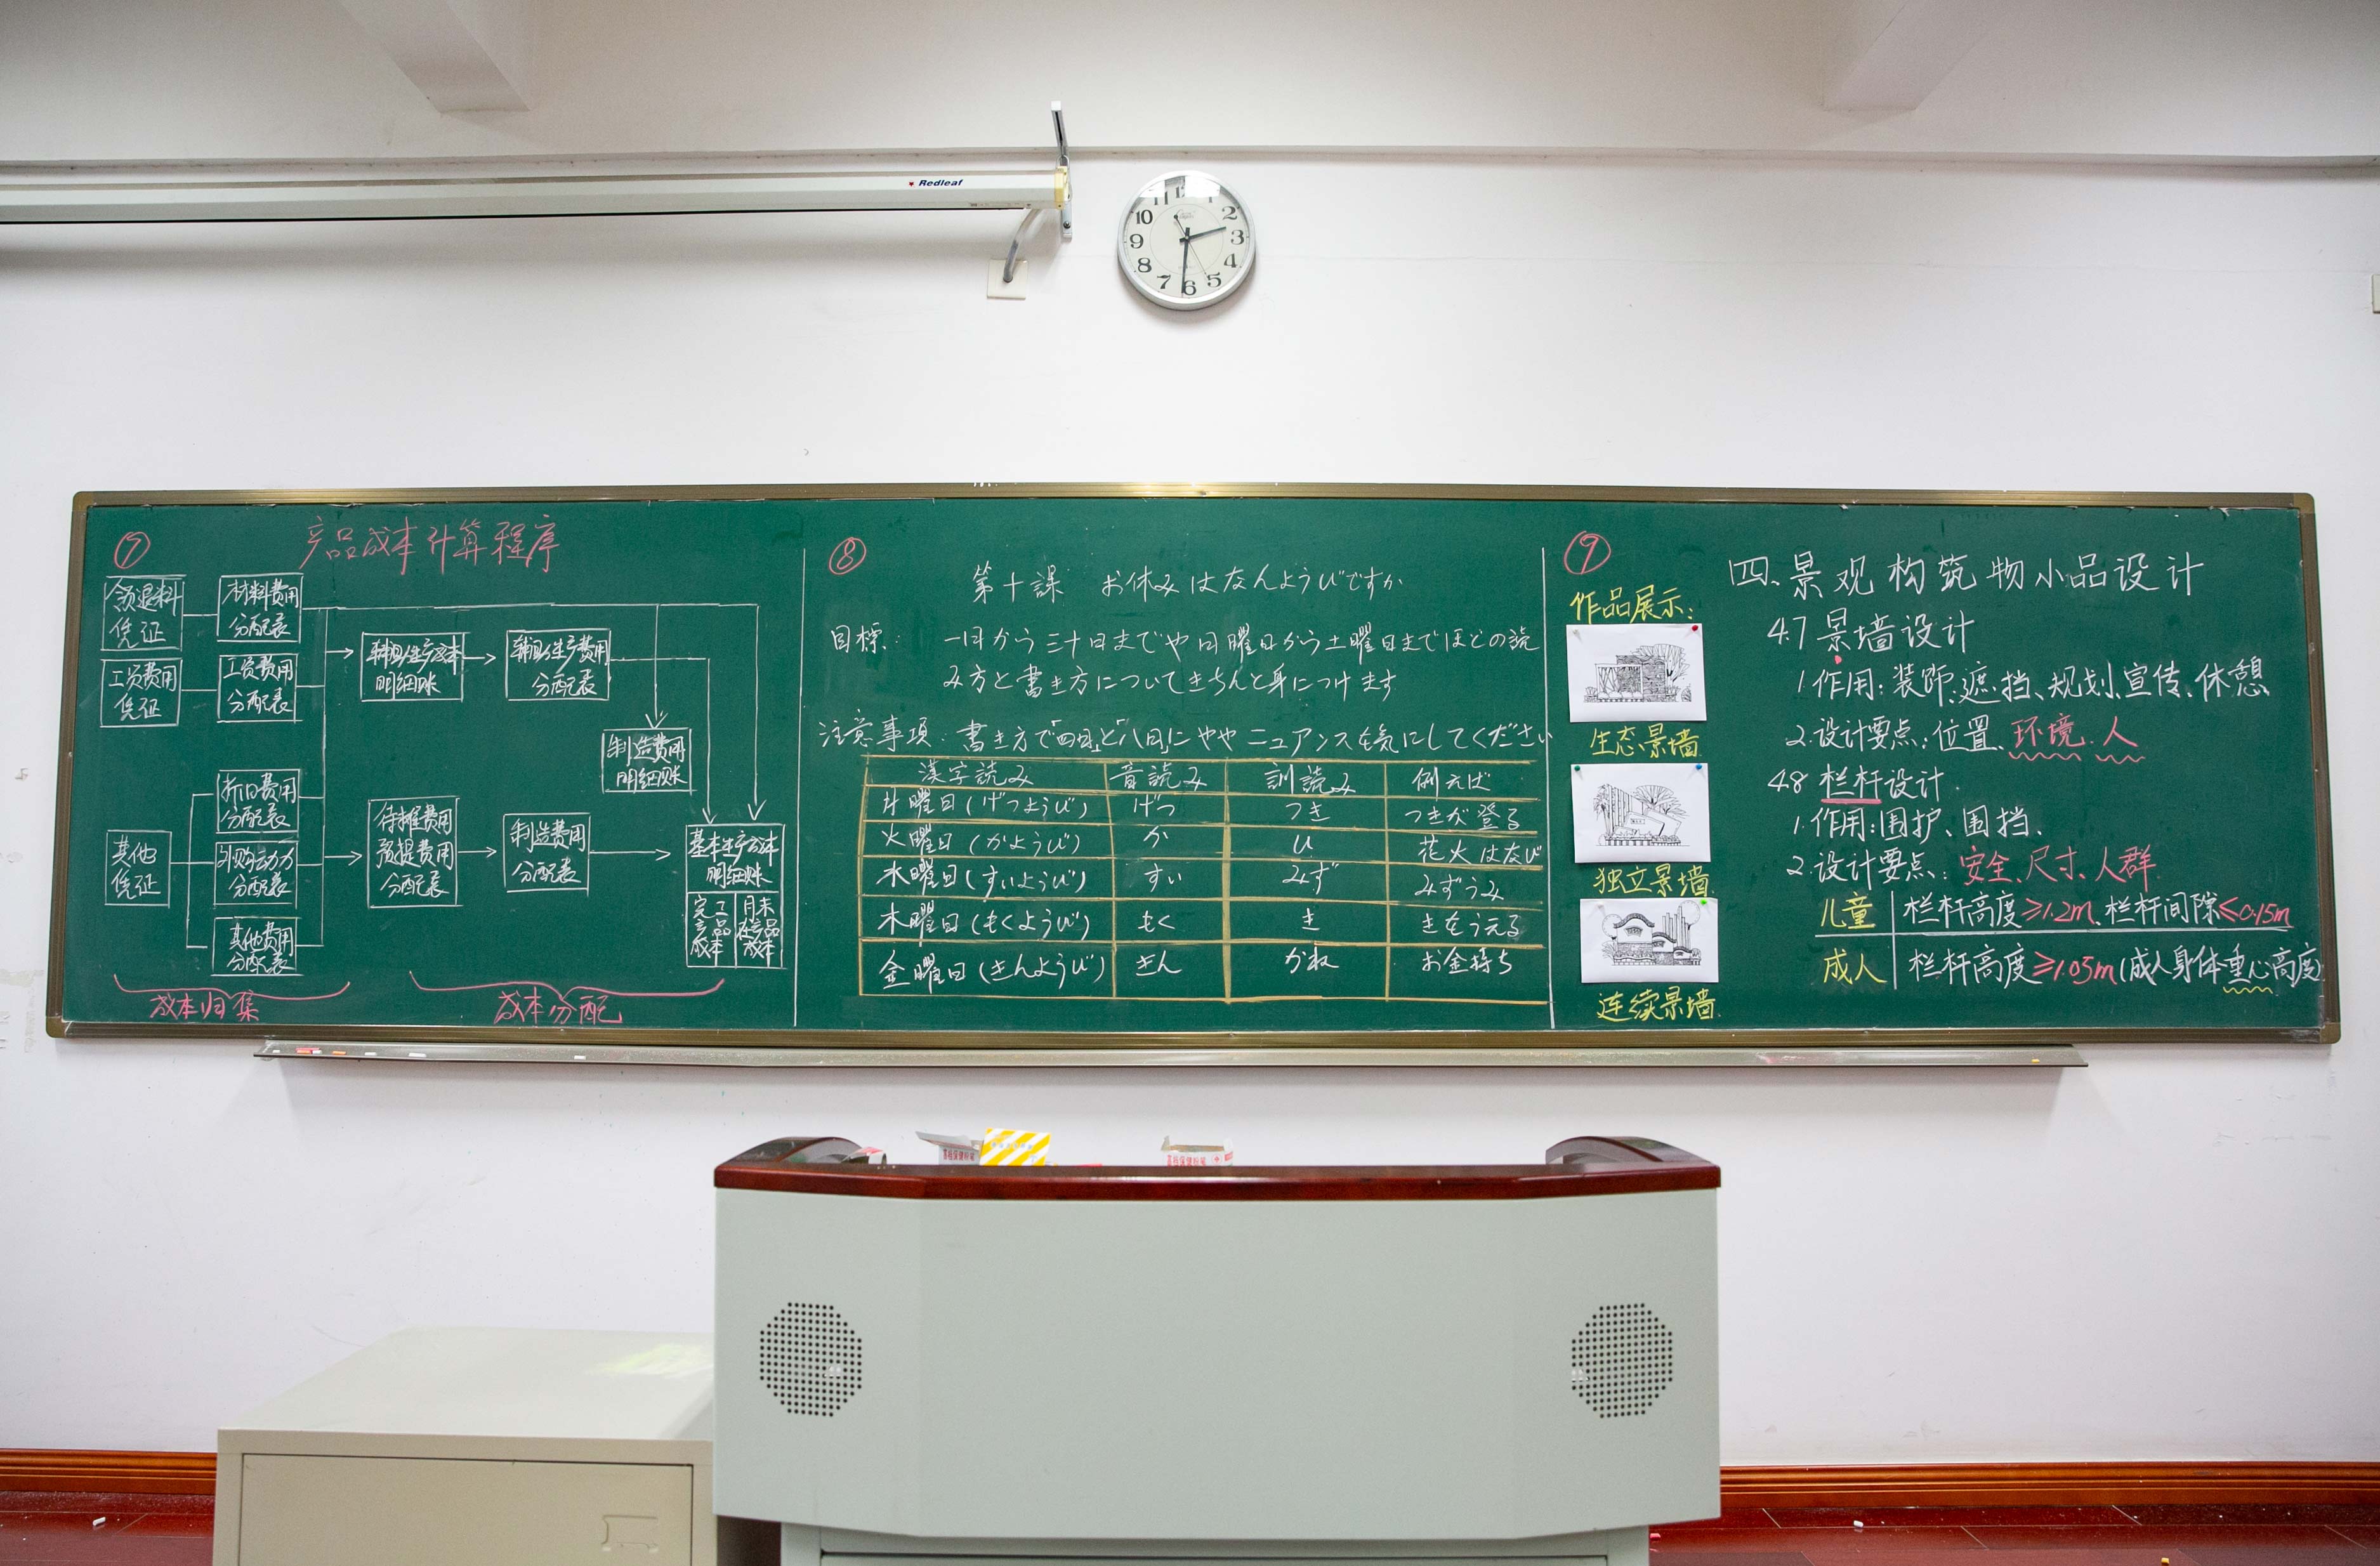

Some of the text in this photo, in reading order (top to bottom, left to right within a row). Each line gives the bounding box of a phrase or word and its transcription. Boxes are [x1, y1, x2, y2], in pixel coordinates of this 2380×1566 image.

[918, 179, 964, 187] Redleaf
[1136, 209, 1154, 225] 10
[1222, 206, 1238, 221] 2
[1129, 234, 1144, 249] 9
[1230, 230, 1245, 246] 3
[1138, 258, 1152, 273] 8
[1224, 253, 1239, 268] 4
[1157, 275, 1171, 289] 7
[1183, 280, 1197, 296] 6
[1207, 272, 1222, 287] 5
[299, 514, 560, 576] 产品成本计算程序
[222, 579, 300, 610] 材料费用
[971, 560, 1403, 604] 第十課 お休みはなんようびですか
[108, 617, 167, 650] 凭证
[229, 613, 292, 638] 分配表
[223, 654, 294, 682] 工资费用
[510, 634, 609, 674] 辅助生产费用
[107, 661, 177, 692] 工资费用
[376, 671, 442, 700] 明细账
[532, 669, 598, 697] 分配表
[114, 693, 162, 721] 凭证
[227, 689, 293, 716] 分配表
[606, 732, 687, 767] 制造费用
[1589, 722, 1701, 758] 生态景墙
[616, 764, 688, 791] 明细账
[917, 760, 1034, 786] 漢字読み
[1108, 761, 1208, 791] 音読み
[1264, 762, 1357, 796] 訓読み
[1412, 766, 1492, 798] 例えば
[220, 773, 297, 807] 折旧费用
[1133, 792, 1177, 816] げつ
[222, 803, 291, 832] 分配表
[374, 802, 453, 836] 待摊费用
[1285, 801, 1331, 823] つき
[1404, 803, 1522, 831] つきが登る
[509, 819, 587, 853] 制造费用
[687, 827, 780, 867] 基本生产成本
[1143, 825, 1169, 849] か
[1292, 835, 1314, 855] ひ
[111, 836, 157, 865] 其他
[216, 845, 295, 874] 外购动力
[376, 838, 454, 871] 预提费用
[111, 870, 162, 900] 凭证
[228, 871, 293, 898] 分配表
[381, 870, 450, 898] 分配表
[512, 857, 582, 885] 分配表
[706, 862, 773, 890] 明细账
[1143, 863, 1183, 893] すい
[1281, 862, 1340, 895] みず
[1593, 862, 1711, 898] 独立景墙
[1413, 873, 1505, 902] みずうみ
[693, 893, 729, 919] 完工
[744, 894, 775, 924] 月末
[1301, 907, 1320, 931] き
[1820, 892, 1876, 930] 儿童
[692, 918, 732, 939] 产品
[736, 916, 780, 942] 在产品
[1138, 910, 1176, 933] もく
[1421, 910, 1522, 938] きをうえる
[229, 921, 293, 957] 其他费用
[690, 936, 724, 967] 成本
[742, 938, 776, 968] 成本
[227, 951, 296, 973] 分配表
[1134, 949, 1183, 977] きん
[1284, 947, 1340, 974] かね
[1421, 945, 1513, 975] お金持ち
[1822, 947, 1888, 985] 成人
[150, 989, 260, 1023] 成本归集
[493, 985, 623, 1025] 成本分配
[1596, 985, 1716, 1022] 连续景墙
